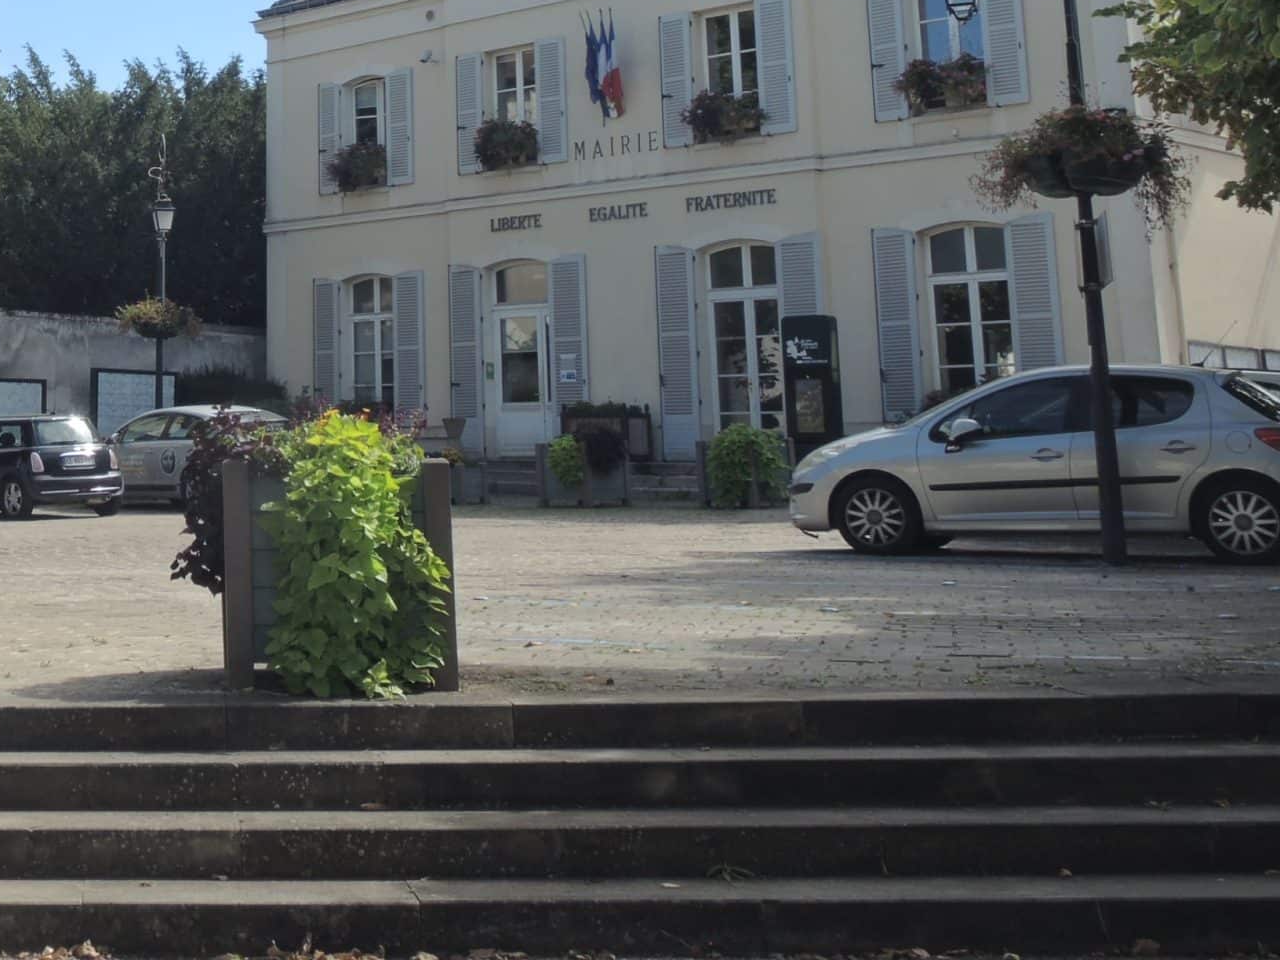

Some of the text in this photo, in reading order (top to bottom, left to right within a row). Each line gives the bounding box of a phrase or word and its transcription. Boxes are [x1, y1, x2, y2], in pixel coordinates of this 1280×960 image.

[574, 130, 659, 161] MAIRIE
[490, 189, 777, 232] LIBERTE EGALITE FRATERNITE
